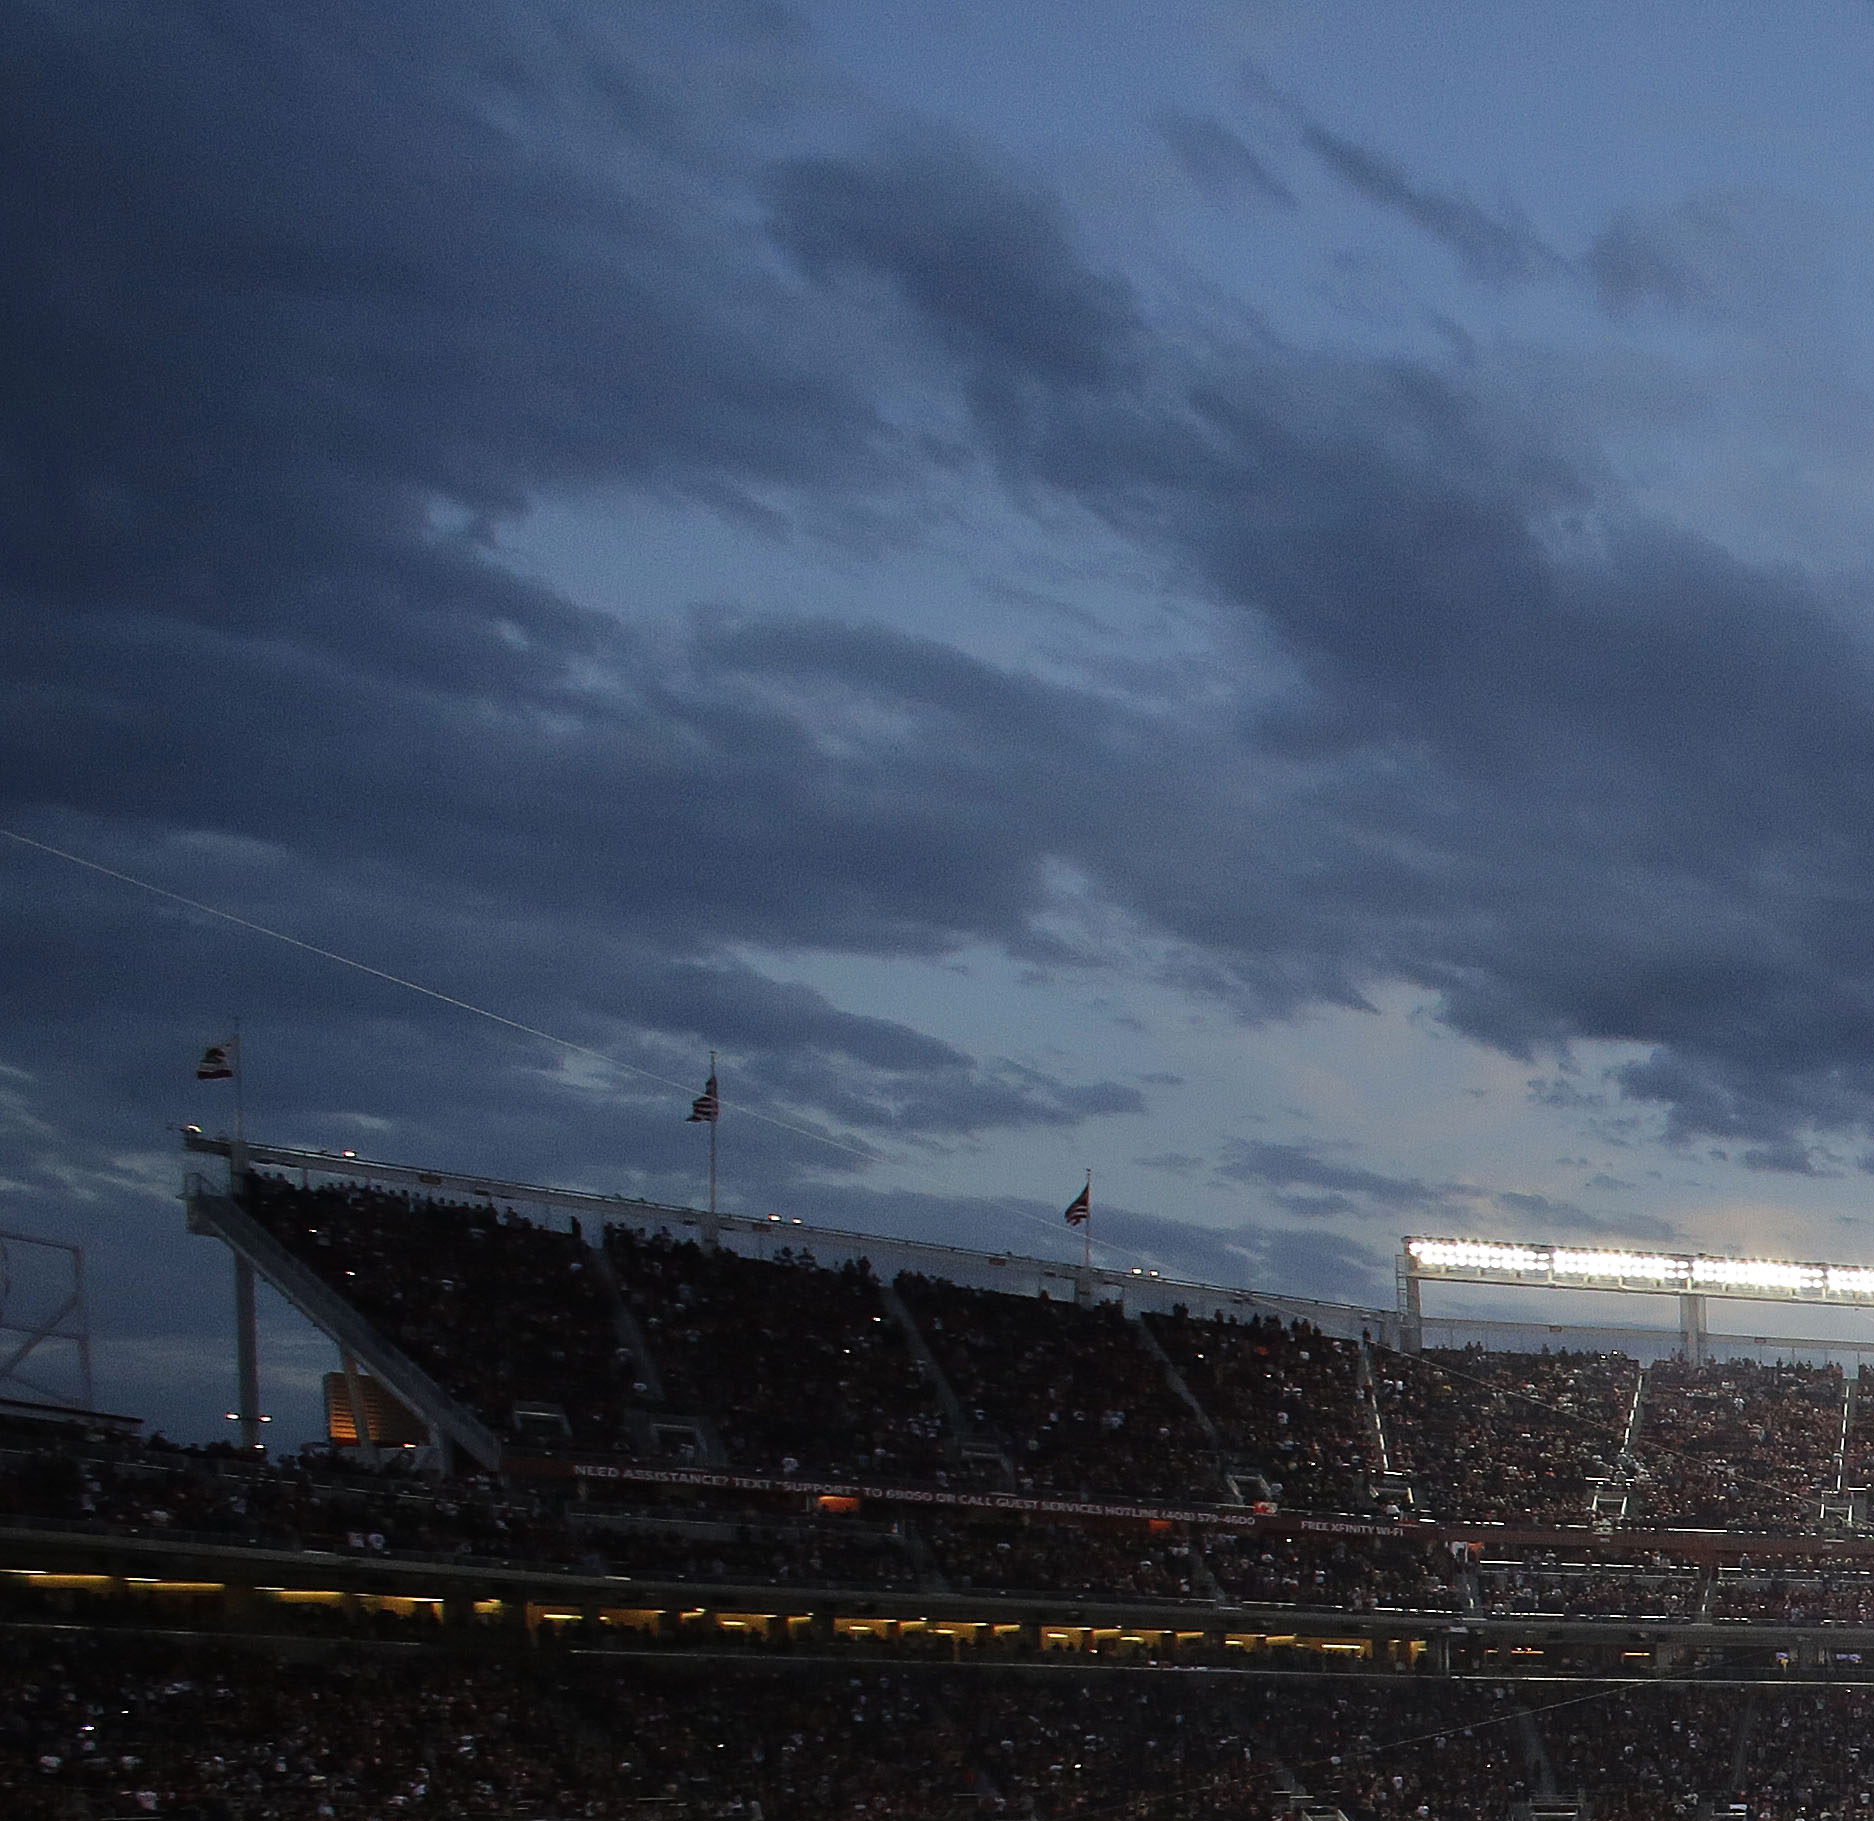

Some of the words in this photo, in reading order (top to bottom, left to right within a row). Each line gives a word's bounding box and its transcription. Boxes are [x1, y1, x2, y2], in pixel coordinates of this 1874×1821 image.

[575, 1465, 620, 1479] NEED
[623, 1468, 729, 1487] ASSISTANCE?
[733, 1477, 773, 1490] TEXT
[864, 1487, 883, 1498] TO
[936, 1492, 957, 1503] OR
[959, 1494, 992, 1507] CALL
[996, 1498, 1039, 1510] GUEST
[1041, 1500, 1103, 1515] SERVICES
[1104, 1506, 1159, 1519] HOTLINE
[1301, 1520, 1329, 1531] FREE
[1330, 1523, 1375, 1535] XFINITY
[1376, 1526, 1404, 1537] WI-FI
